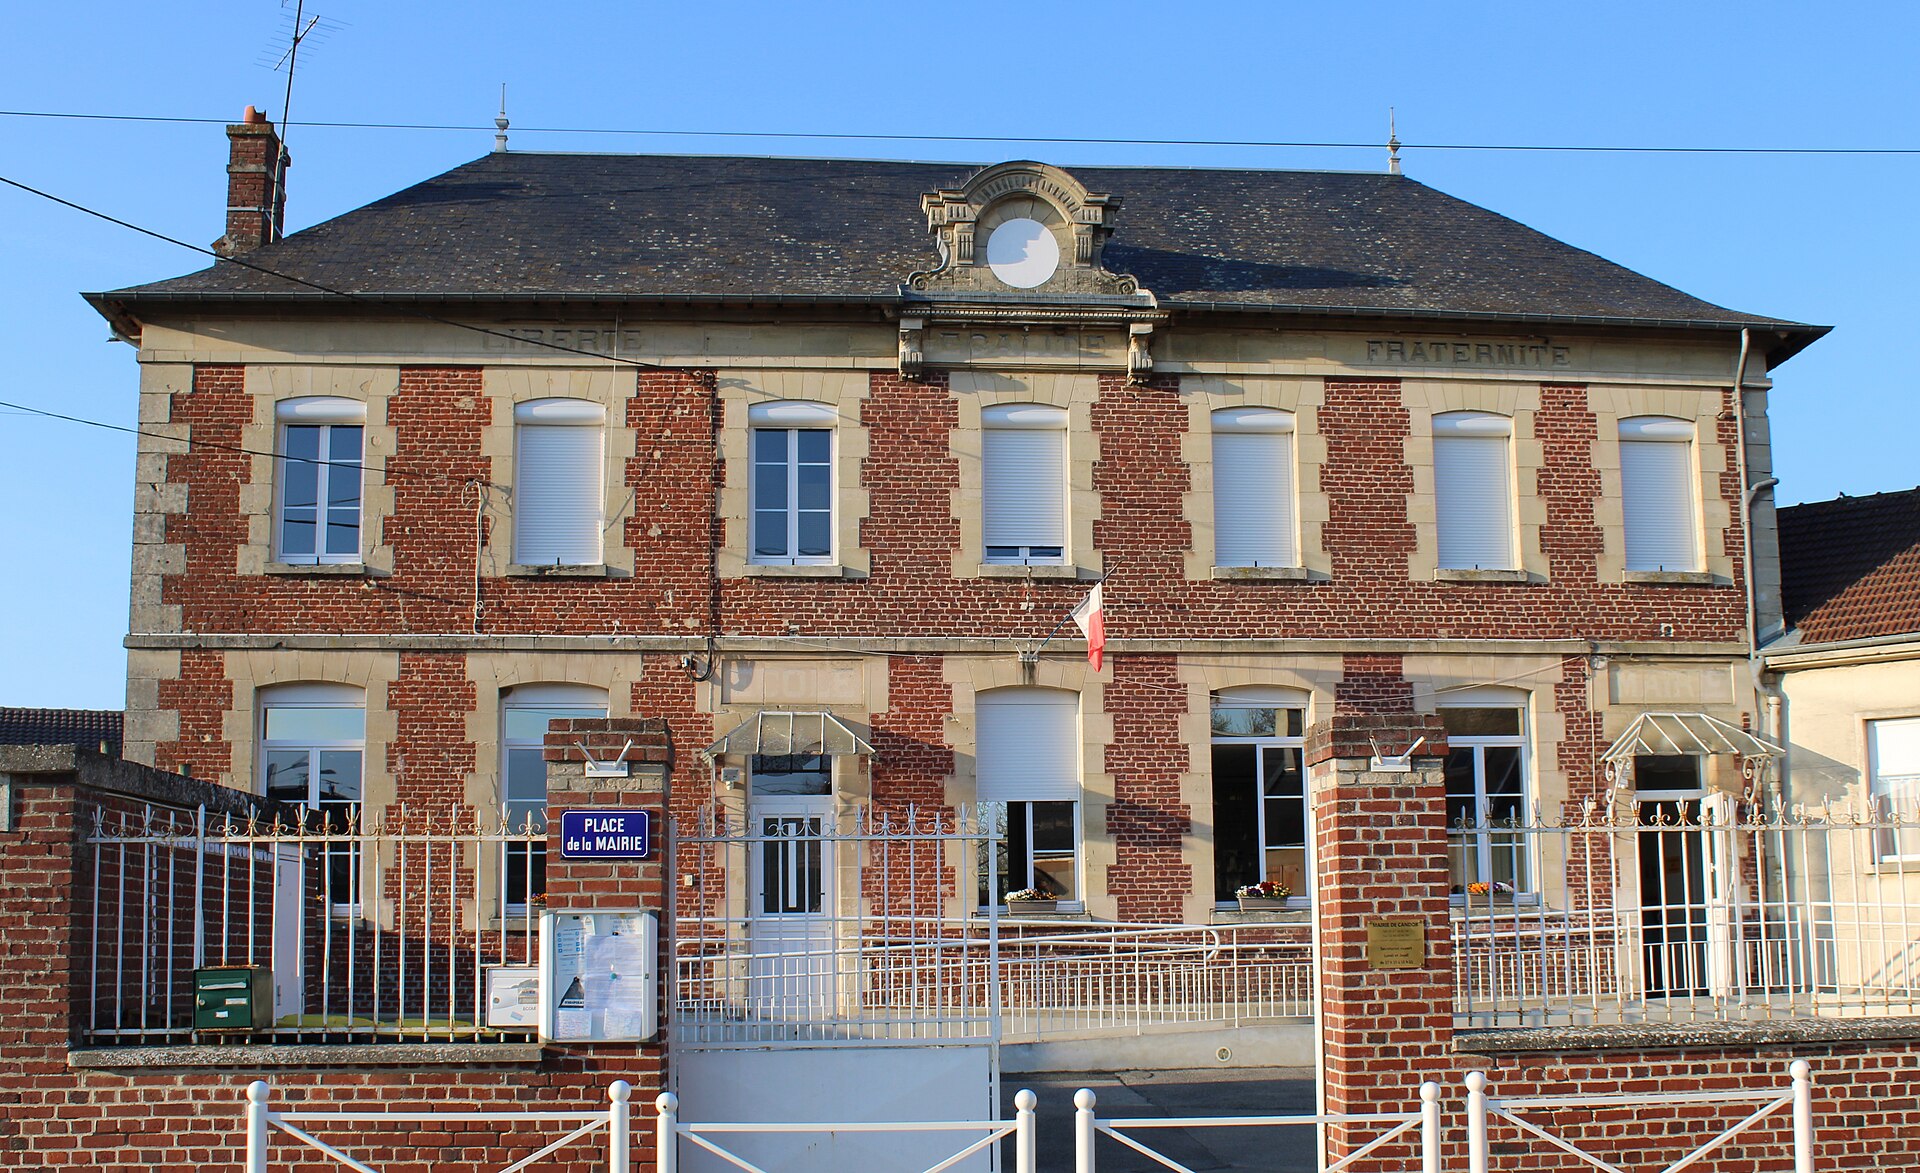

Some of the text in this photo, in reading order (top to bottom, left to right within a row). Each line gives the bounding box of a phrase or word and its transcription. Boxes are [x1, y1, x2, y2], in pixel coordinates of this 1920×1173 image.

[482, 328, 642, 350] LIBERTE
[1366, 340, 1571, 367] FRATERNITE
[584, 818, 625, 833] PLACE
[567, 836, 643, 851] de la MAIRIE
